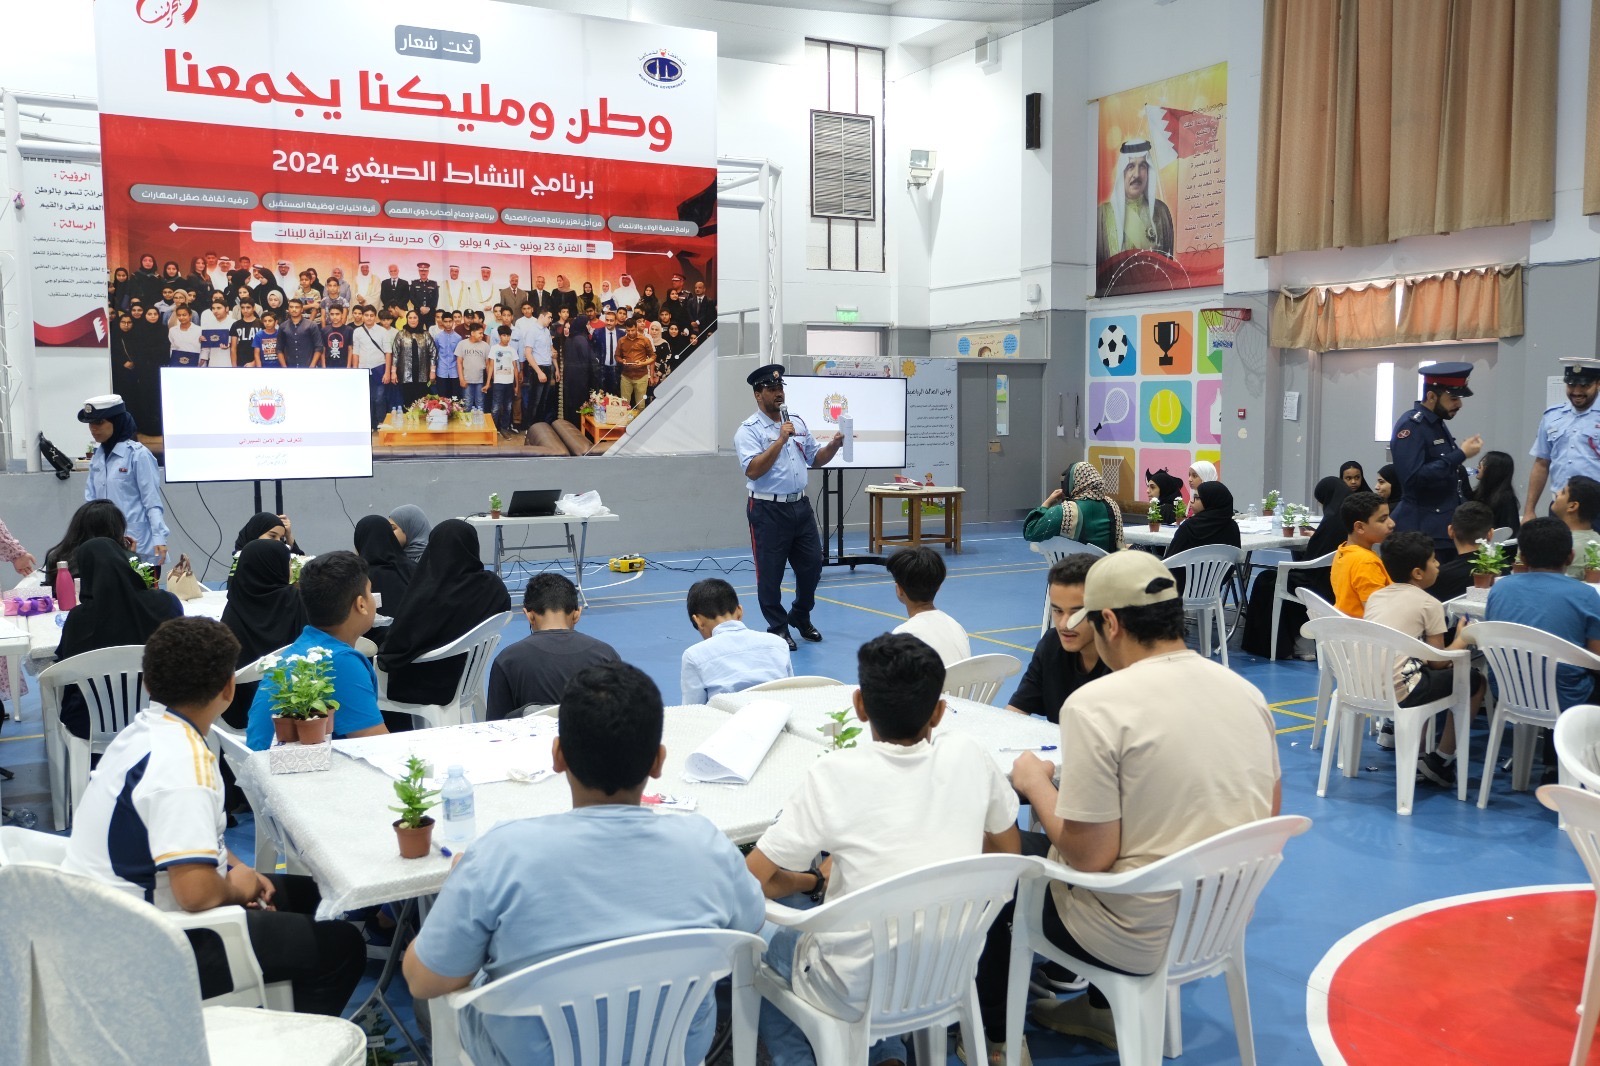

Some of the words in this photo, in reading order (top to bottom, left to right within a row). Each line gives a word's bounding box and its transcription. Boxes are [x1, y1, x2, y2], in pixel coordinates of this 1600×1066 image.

[399, 33, 438, 51] شعار
[442, 37, 474, 55] تحت
[164, 48, 342, 120] يجمعنا
[359, 71, 555, 141] ومليكنا
[565, 97, 673, 152] وطن
[272, 149, 339, 175] 2024
[60, 171, 91, 182] الرؤية
[345, 160, 436, 184] الصيفي
[443, 162, 524, 189] النشاط
[35, 186, 62, 196] بالوطن
[531, 172, 594, 199] برنامج
[141, 190, 178, 200] المهارات
[179, 193, 200, 201] صقل
[268, 200, 306, 209] المستقبل
[306, 201, 335, 211] لوظيفة
[336, 204, 362, 212] اختيارك
[388, 207, 413, 215] الهمم
[413, 208, 429, 217] ذوي
[430, 208, 453, 217] أصحاب
[474, 212, 495, 220] برنامج
[504, 213, 528, 223] الصحية
[528, 215, 546, 224] المدن
[546, 217, 566, 226] برنامج
[60, 219, 96, 231] الرسالة
[592, 220, 602, 228] من
[274, 228, 307, 240] للبنات
[308, 229, 352, 242] الابتدائية
[354, 231, 385, 243] كرانة
[388, 233, 424, 245] مدرسة
[459, 237, 482, 248] يوليو
[484, 238, 490, 247] 4
[493, 239, 511, 250] حتى
[520, 242, 542, 253] يونيو
[544, 242, 555, 251] 23
[558, 243, 582, 254] الفترة
[236, 327, 262, 341] PLAY
